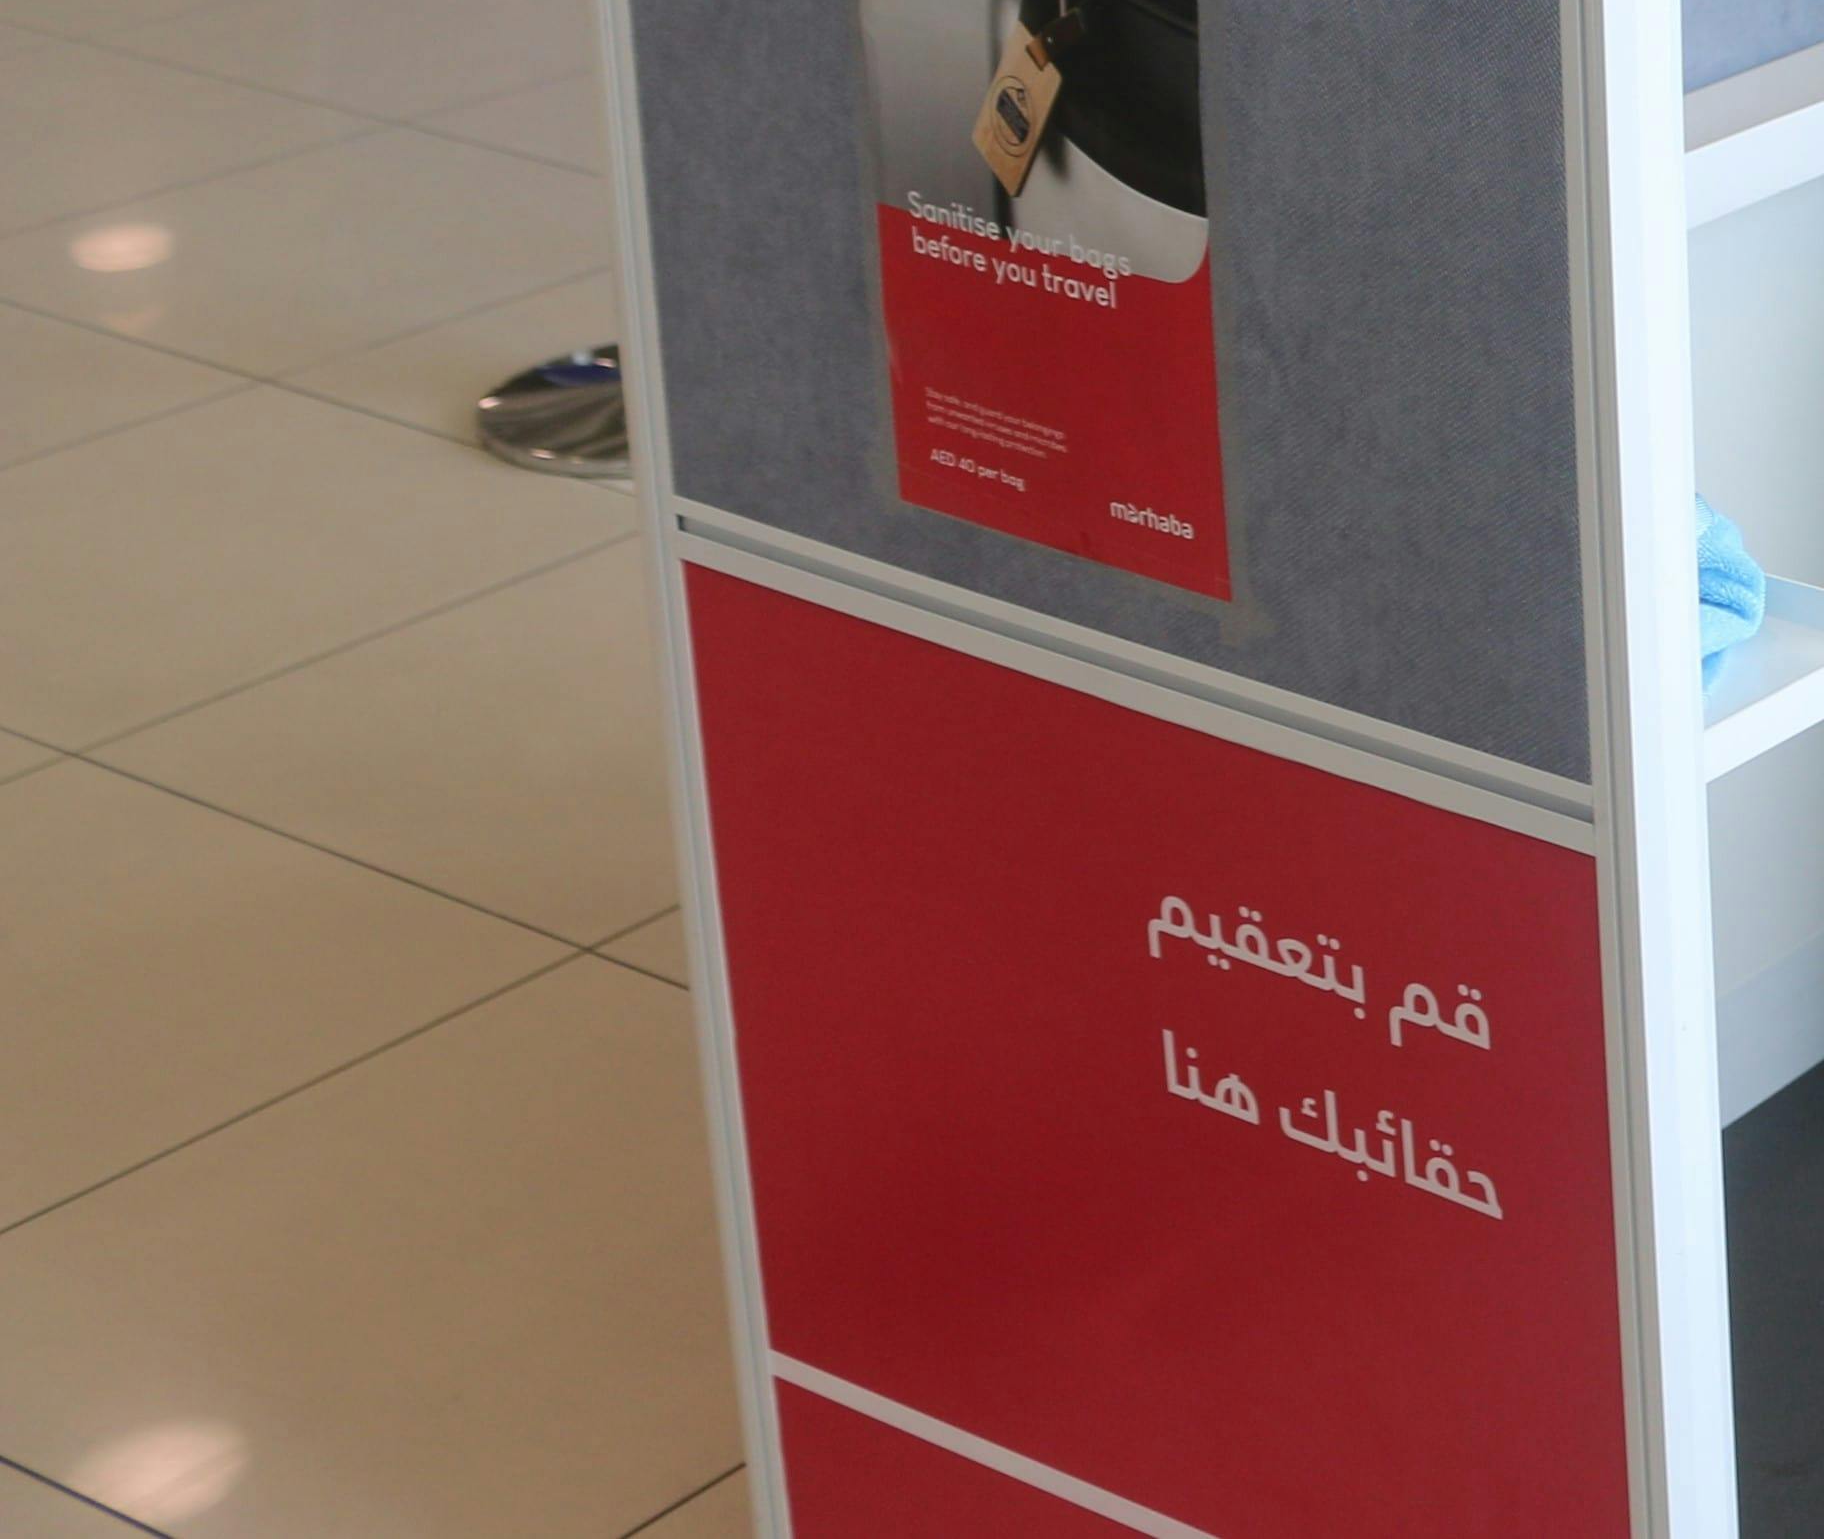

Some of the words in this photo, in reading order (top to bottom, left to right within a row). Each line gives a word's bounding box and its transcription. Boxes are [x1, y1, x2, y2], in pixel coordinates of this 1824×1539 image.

[907, 191, 1001, 241] Sanitise
[1006, 225, 1068, 257] your
[1069, 235, 1132, 280] bags
[912, 227, 987, 272] before
[992, 256, 1036, 286] you
[1041, 265, 1117, 309] travel
[930, 448, 956, 467] AED
[959, 457, 975, 473] 40
[977, 464, 1000, 478] per
[1000, 468, 1026, 493] bag
[1146, 894, 1367, 1020] بتعقيم
[1388, 982, 1492, 1051] قم
[1161, 1028, 1260, 1125] هنا
[1278, 1089, 1504, 1221] حقائبك
